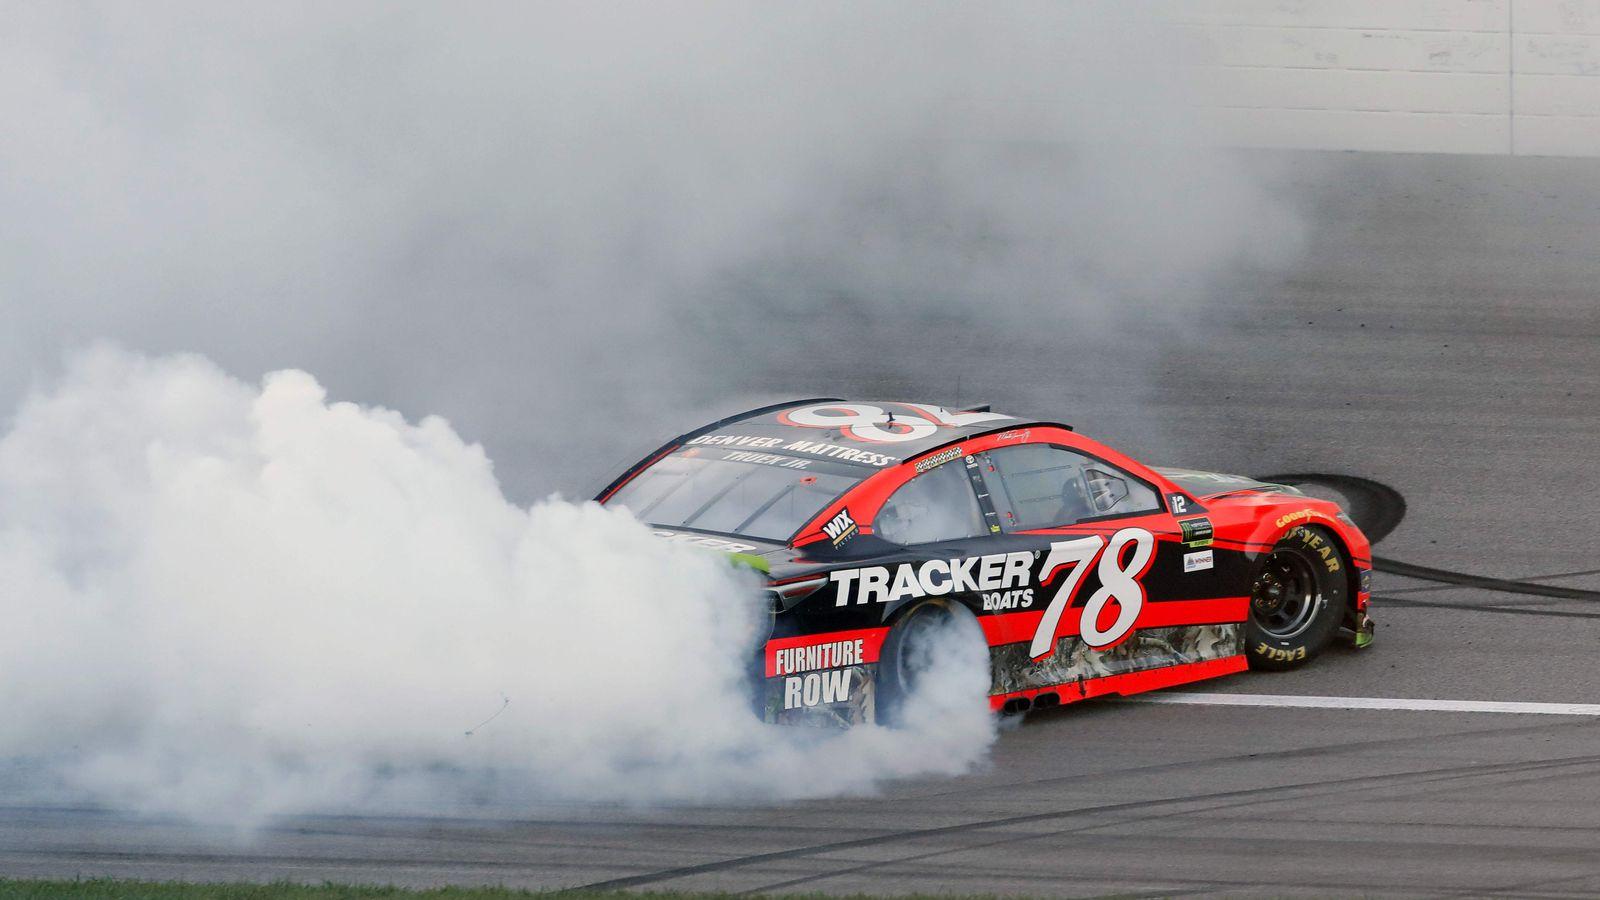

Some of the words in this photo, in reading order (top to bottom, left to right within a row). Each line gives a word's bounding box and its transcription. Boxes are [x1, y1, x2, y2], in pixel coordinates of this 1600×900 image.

[688, 435, 783, 448] DENVER
[783, 440, 896, 466] MATTRESS
[1171, 495, 1187, 514] 12
[823, 508, 856, 540] WIX
[829, 550, 1034, 608] TRACKER
[1029, 526, 1156, 660] 78
[982, 588, 1034, 612] BOATS
[776, 638, 864, 676] FURNITURE
[1255, 641, 1306, 662] EAGLE
[784, 668, 852, 710] ROW
